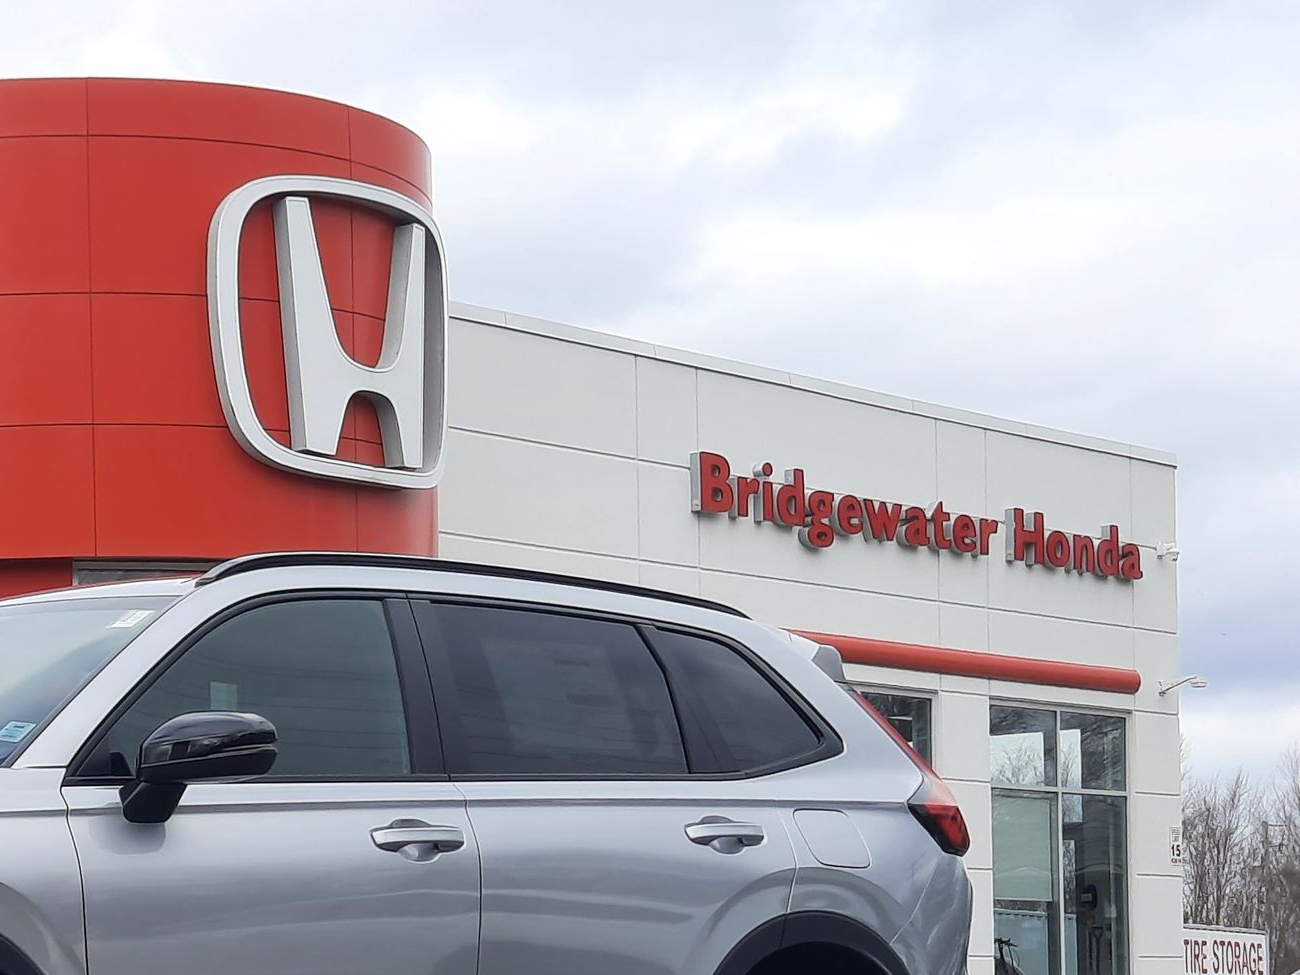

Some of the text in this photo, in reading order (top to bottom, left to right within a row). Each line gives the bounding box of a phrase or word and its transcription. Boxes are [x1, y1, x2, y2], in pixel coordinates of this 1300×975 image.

[694, 451, 1143, 580] Bridgewater Honda
[1171, 844, 1181, 857] 15
[1184, 939, 1264, 975] TIRE STORAGE
